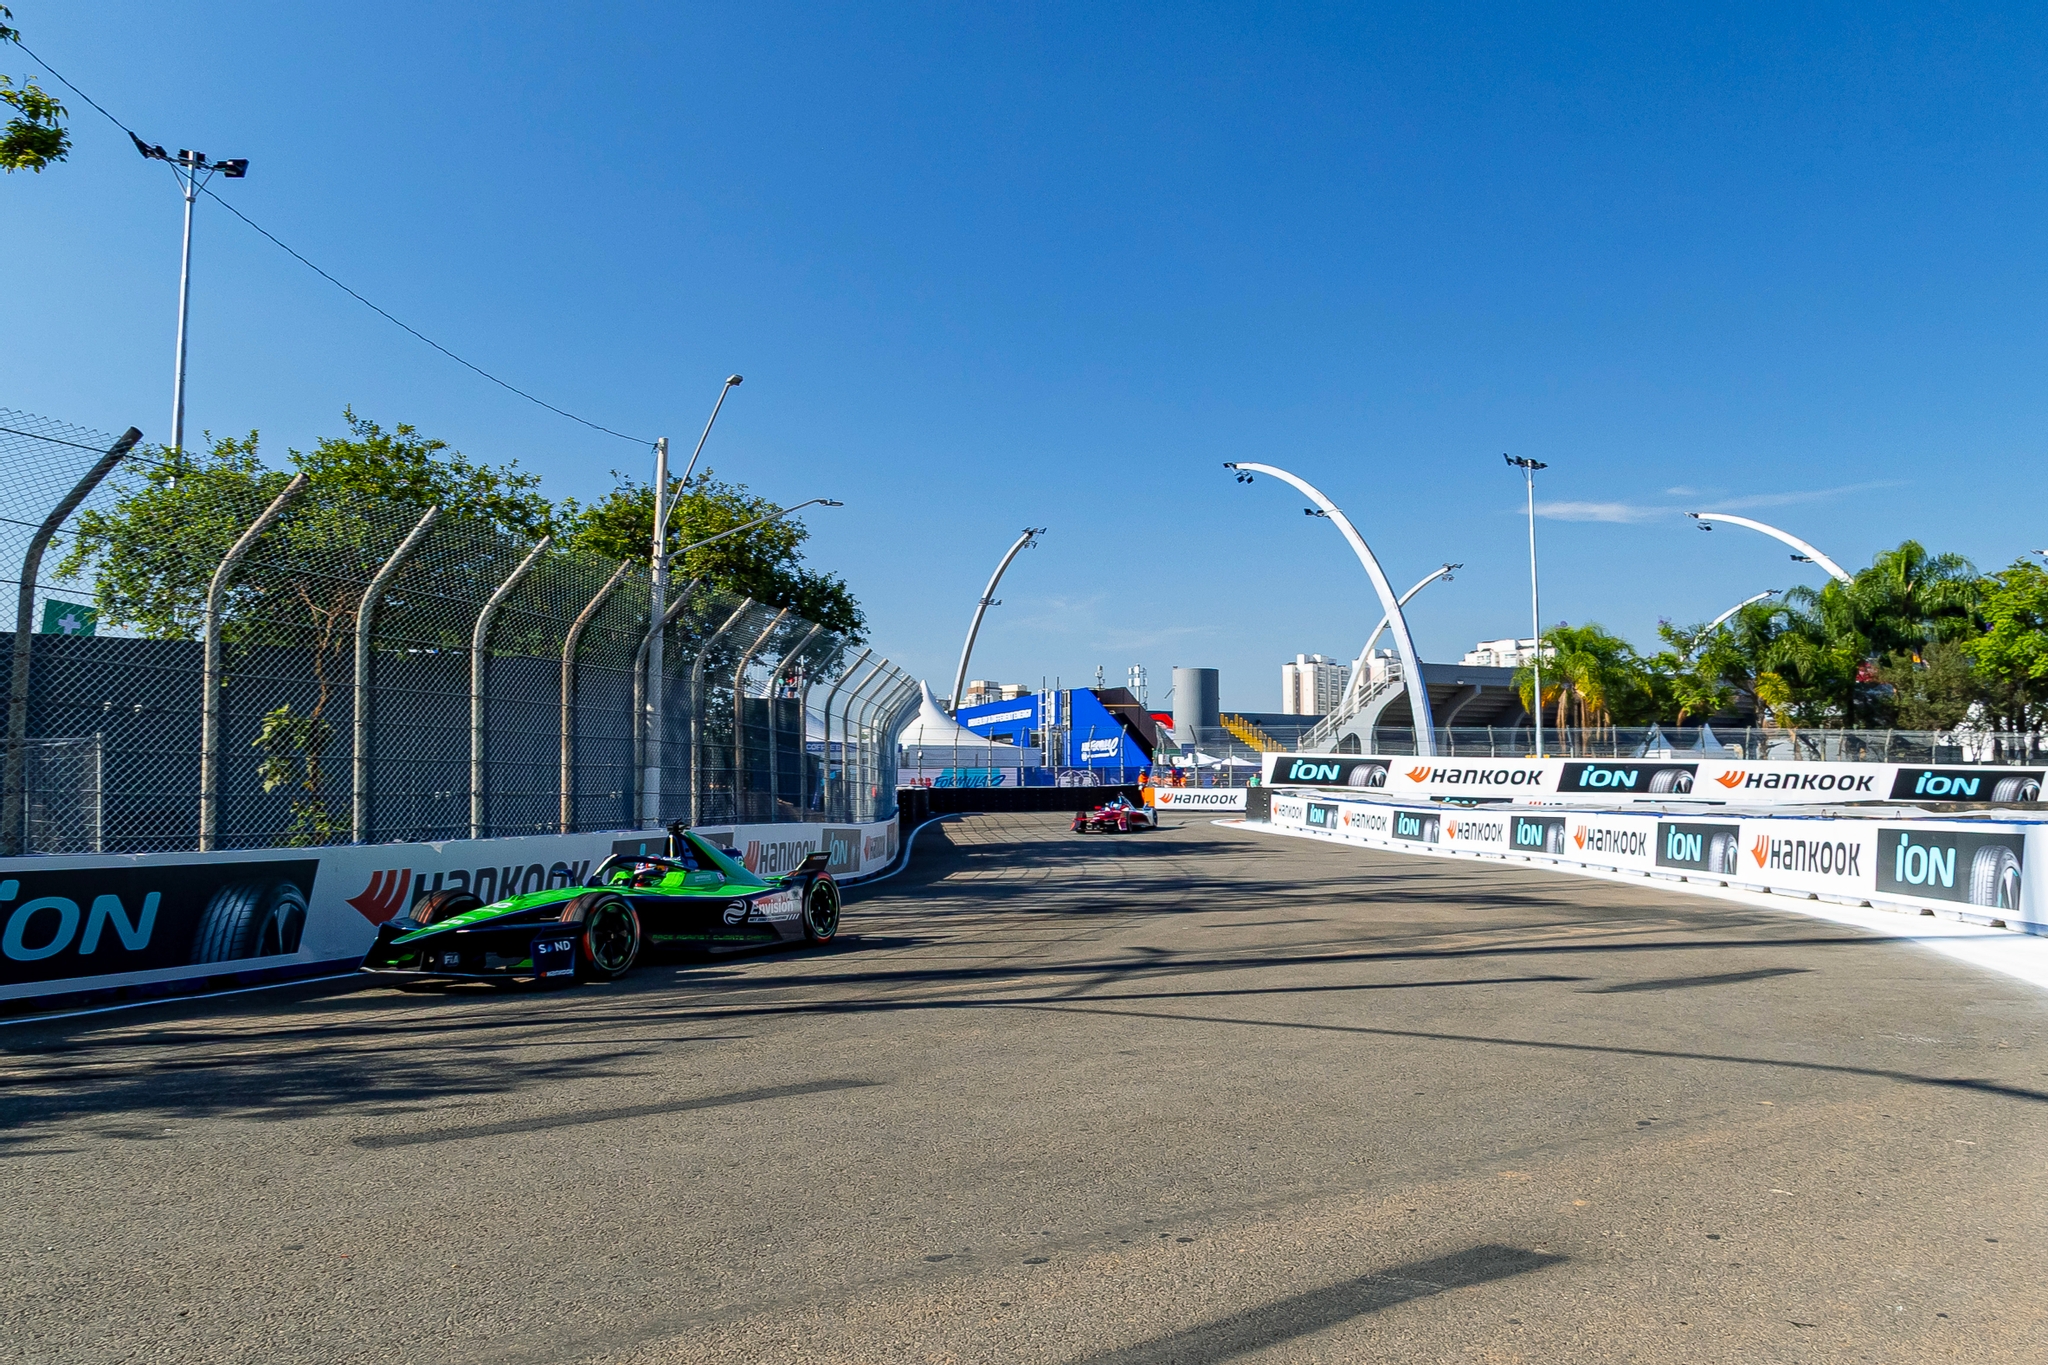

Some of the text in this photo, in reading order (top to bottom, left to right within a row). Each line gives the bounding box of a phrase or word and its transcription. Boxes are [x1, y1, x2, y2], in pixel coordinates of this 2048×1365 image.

[1289, 759, 1341, 780] iON
[1578, 765, 1639, 788] iON
[1915, 771, 1980, 796] iON
[1397, 812, 1420, 836] iON
[1516, 818, 1543, 847] iON
[1667, 825, 1702, 863] iON
[1896, 833, 1957, 889] iON
[750, 899, 794, 915] Envision
